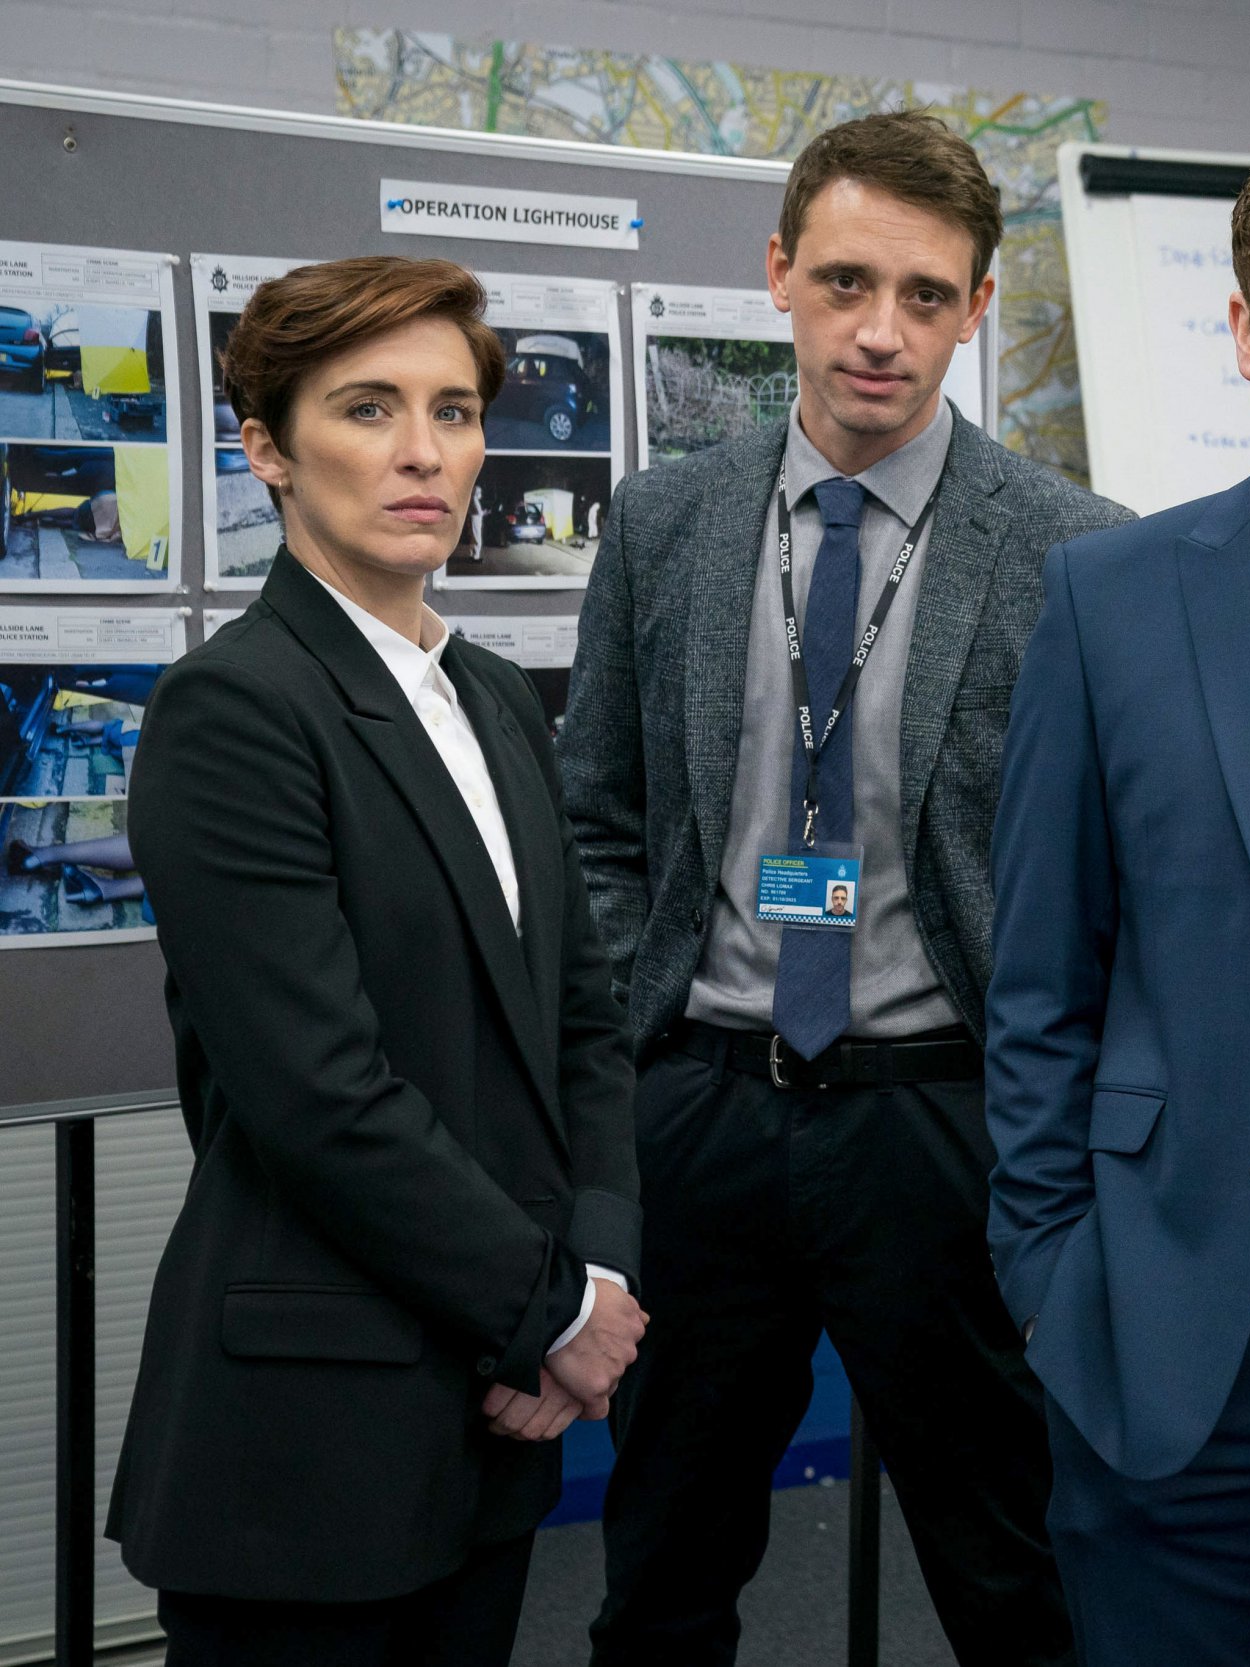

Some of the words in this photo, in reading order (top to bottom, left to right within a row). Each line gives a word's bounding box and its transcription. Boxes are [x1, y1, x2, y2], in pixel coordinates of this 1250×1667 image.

[401, 198, 507, 222] OPERATION
[513, 207, 620, 230] LIGHTHOUSE
[153, 540, 161, 562] 1
[779, 533, 790, 574] POLICE
[890, 543, 914, 583] POLICE
[786, 617, 800, 660] POLICE
[853, 624, 878, 667] POLICE
[799, 706, 814, 750] POLICE
